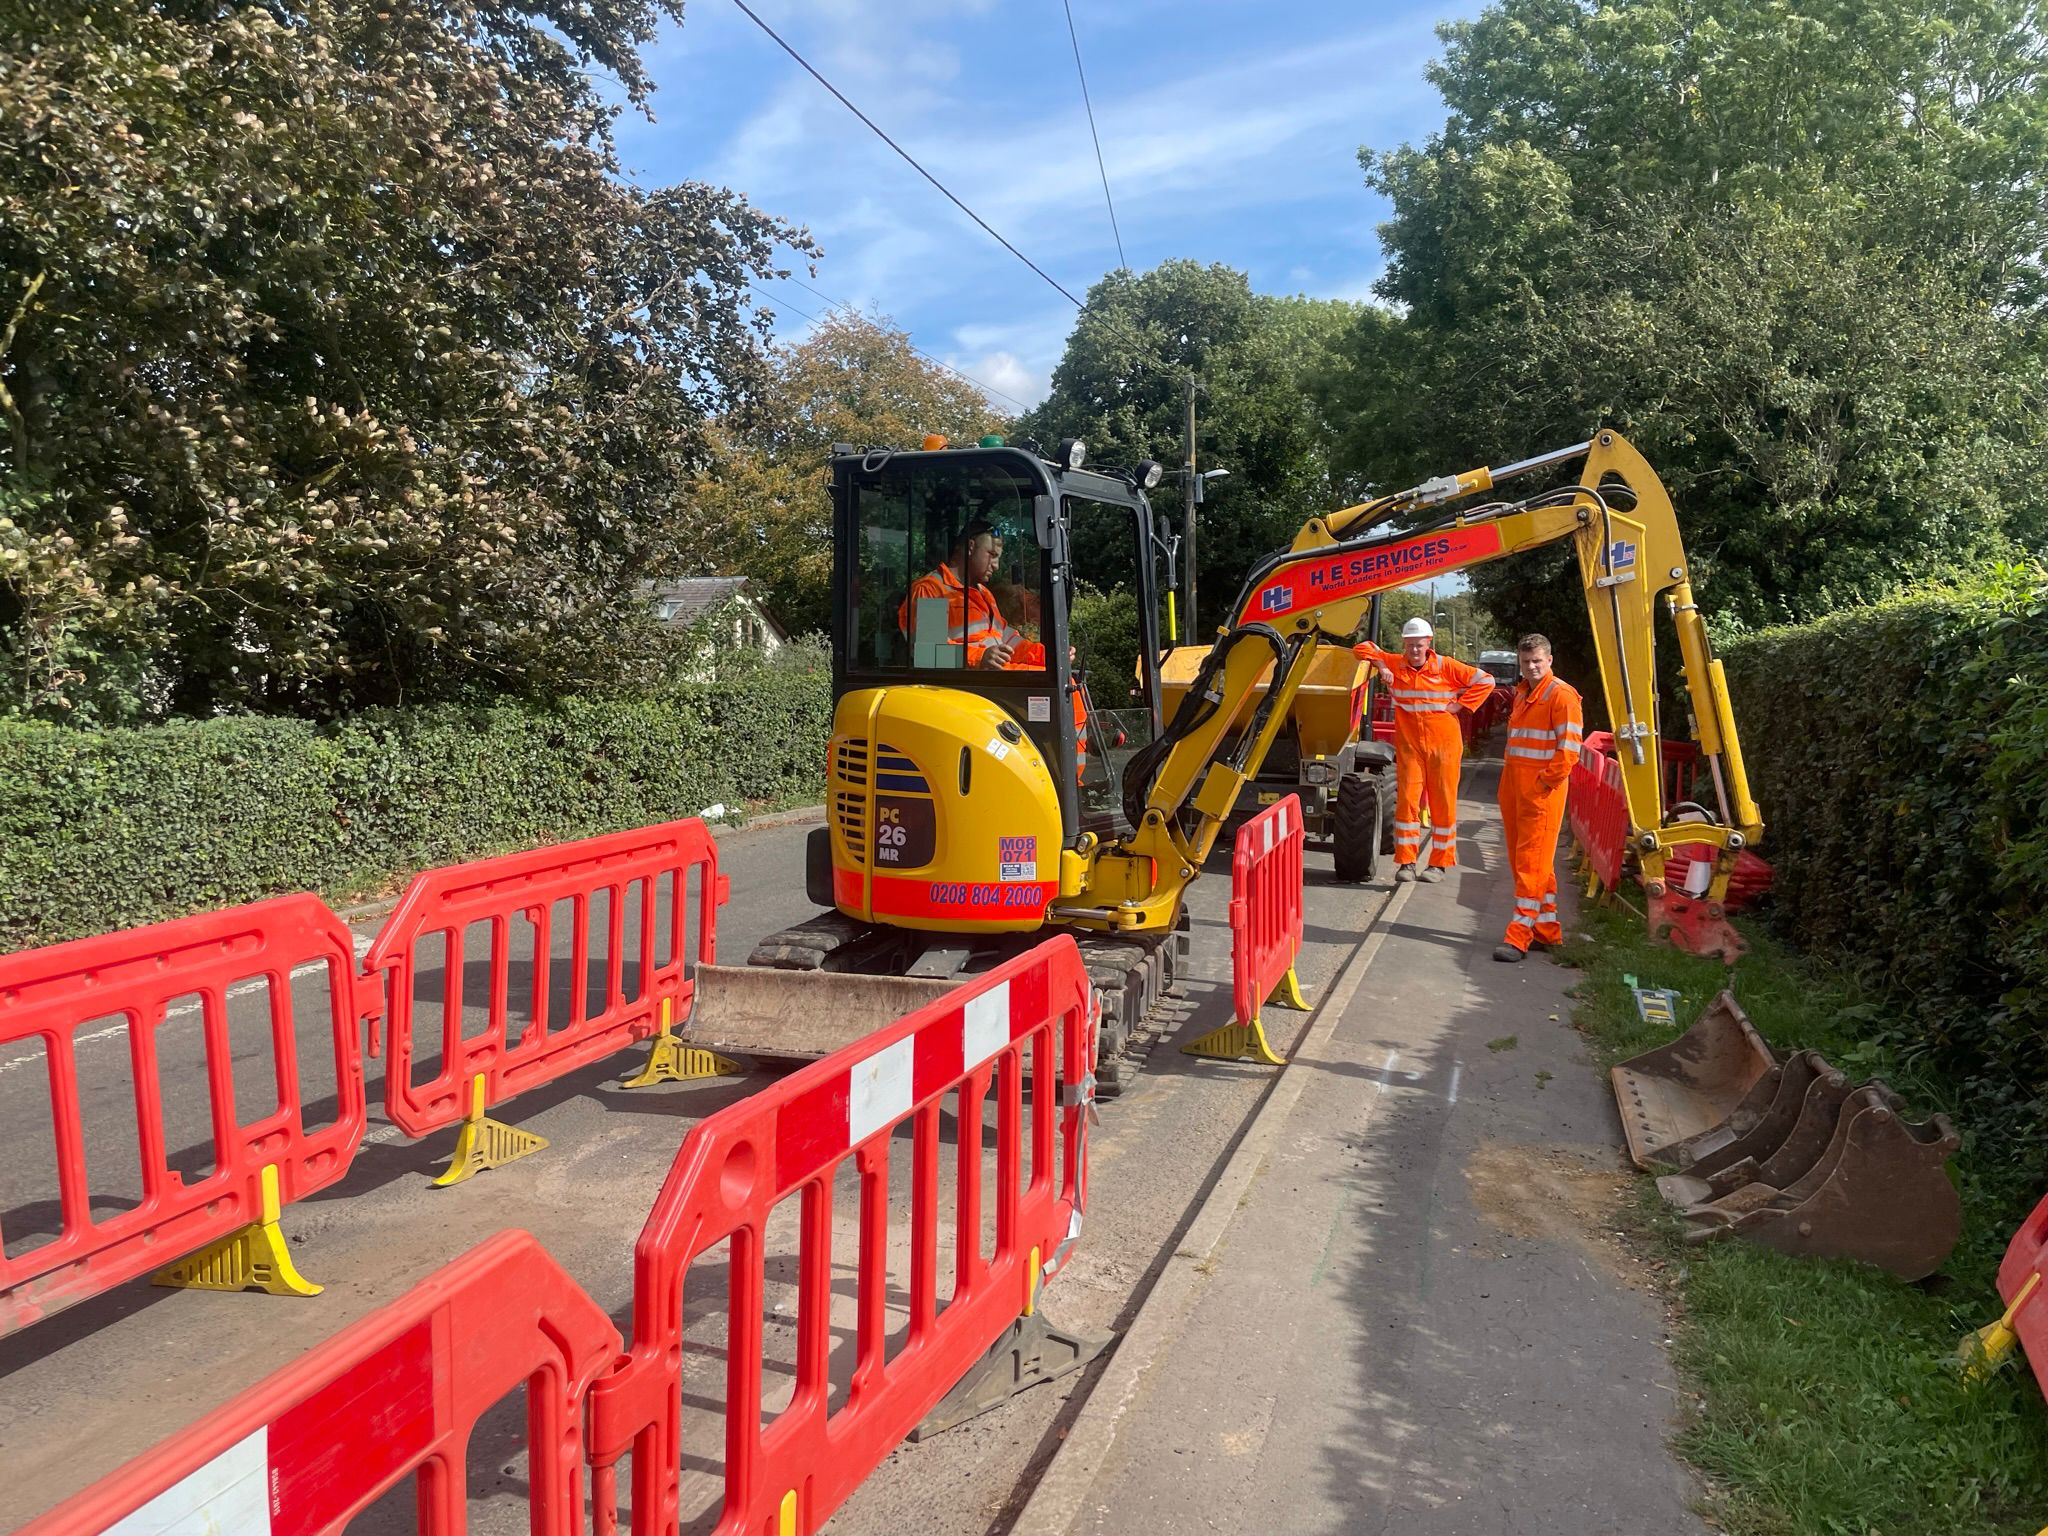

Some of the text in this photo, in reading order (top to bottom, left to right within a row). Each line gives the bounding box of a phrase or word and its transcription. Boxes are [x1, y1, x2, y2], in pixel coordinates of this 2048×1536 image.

[1311, 569, 1324, 586] H
[1331, 565, 1343, 581] E
[1350, 539, 1450, 576] SERVICES
[1322, 557, 1444, 591] World Leaders in Digger Hire
[880, 807, 900, 824] PC
[879, 825, 907, 846] 26
[1001, 838, 1035, 850] M08
[879, 847, 899, 861] MR
[1003, 850, 1032, 862] 071
[930, 884, 1042, 906] 0208 804 2000
